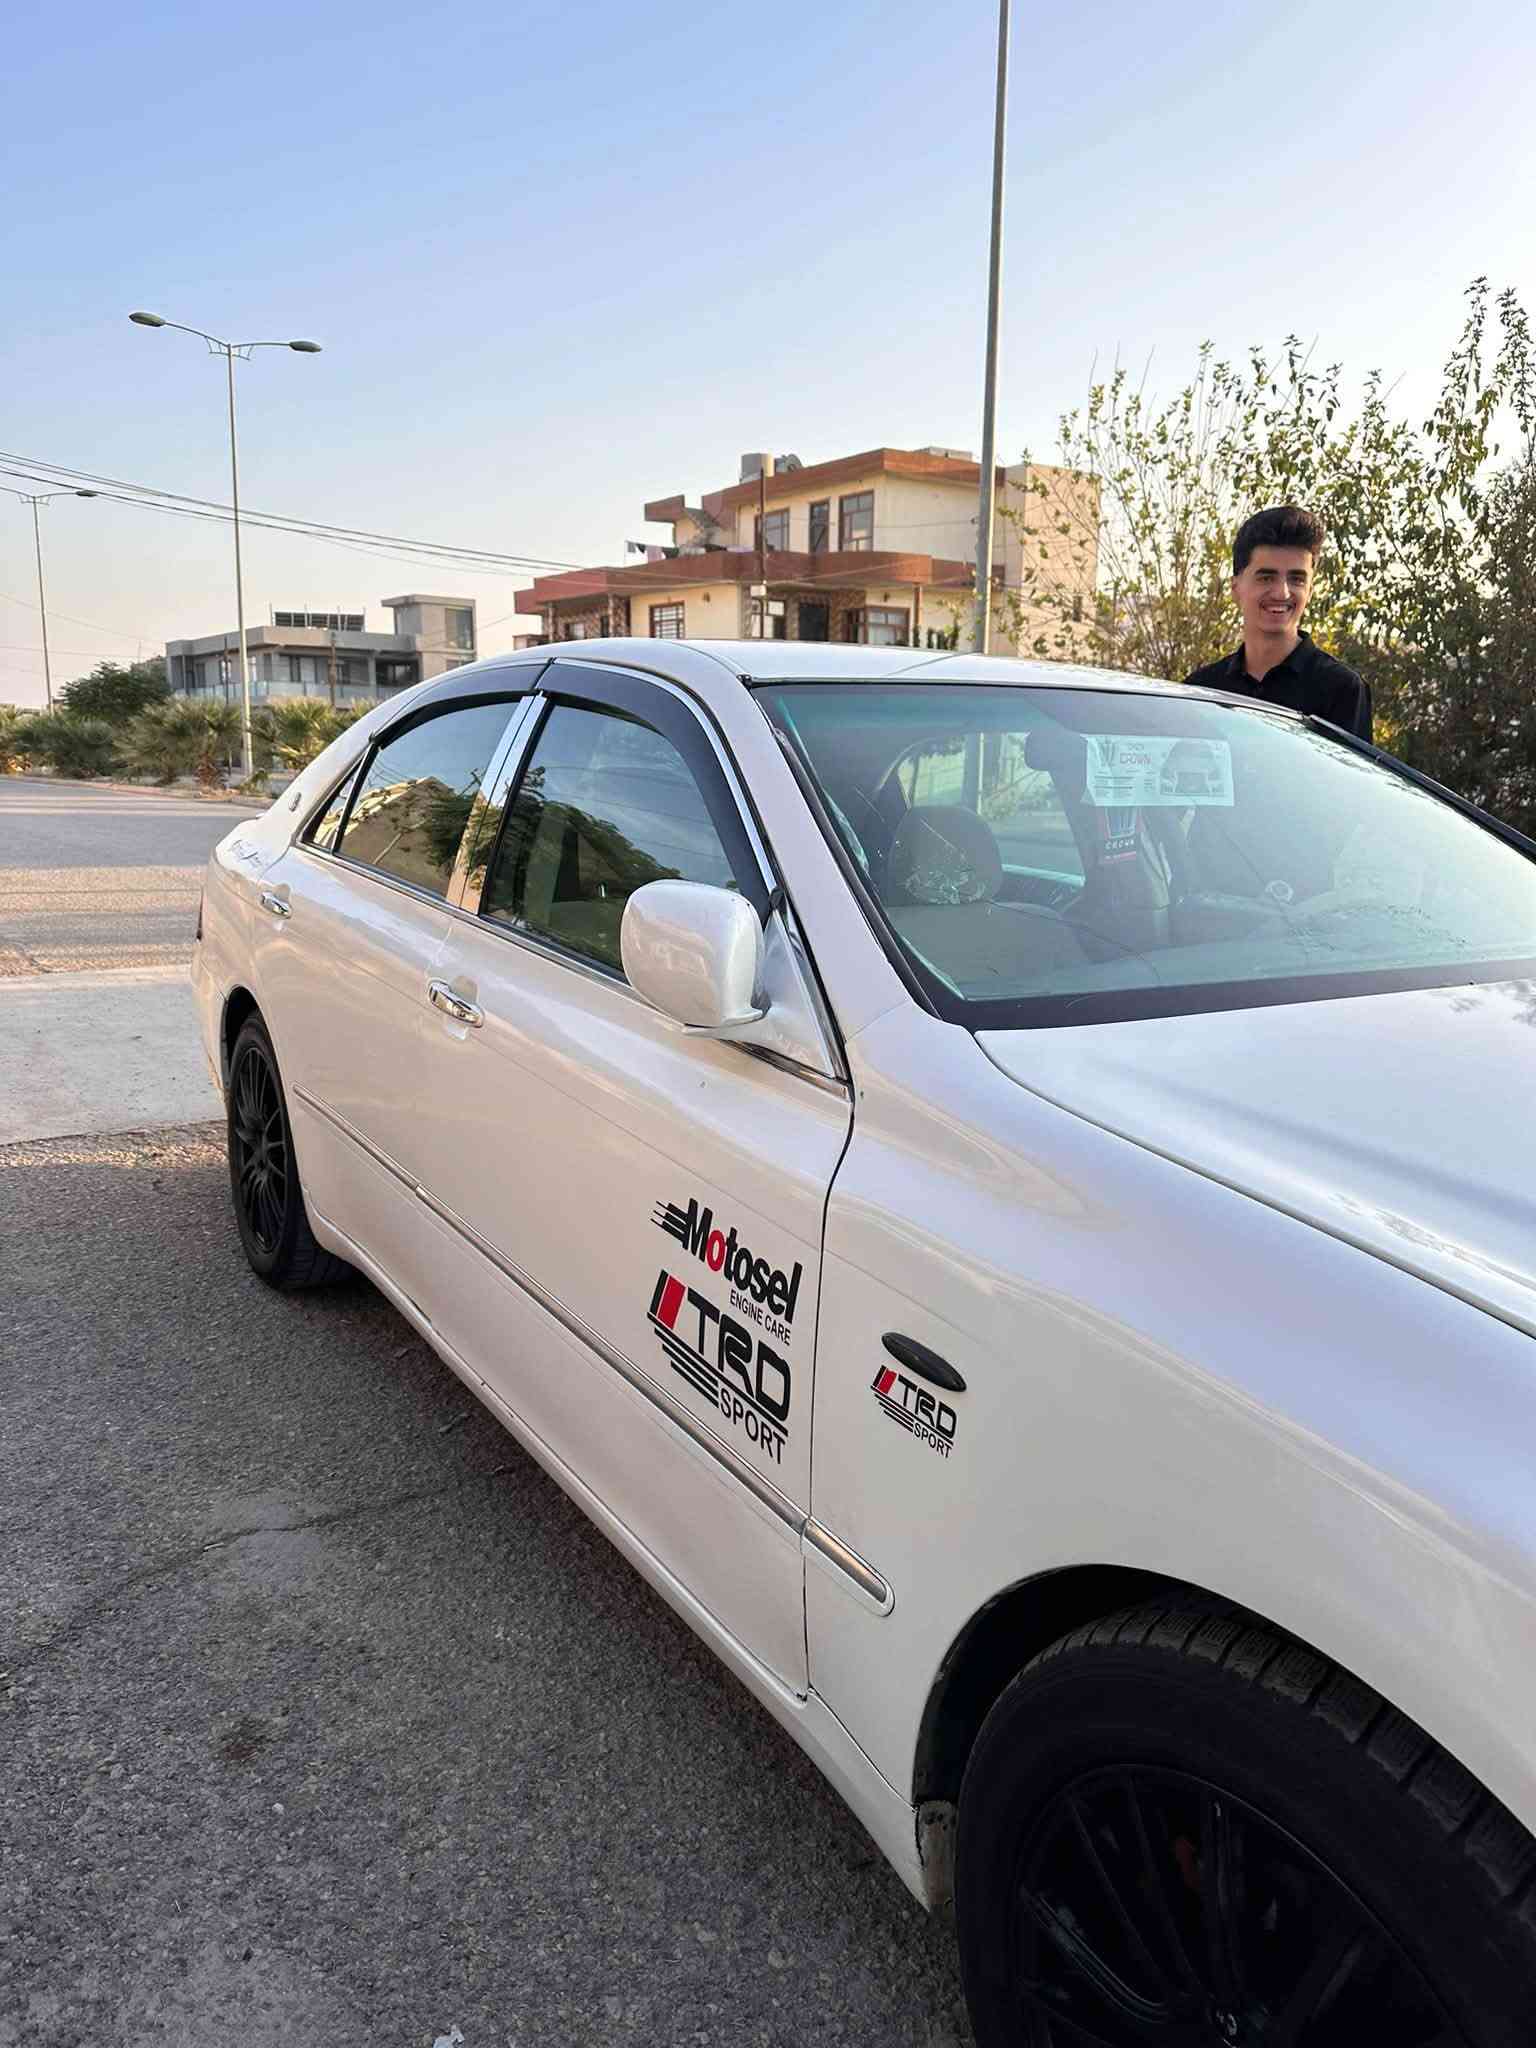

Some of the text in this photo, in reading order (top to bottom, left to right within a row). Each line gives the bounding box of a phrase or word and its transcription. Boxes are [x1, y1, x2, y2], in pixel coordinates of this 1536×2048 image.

[684, 1198, 803, 1324] Motosel
[730, 1289, 791, 1346] ENGINE CARE
[687, 1286, 792, 1422] TRD
[720, 1387, 786, 1465] SPORT
[898, 1373, 958, 1440] TRD
[914, 1422, 952, 1459] SPORT
